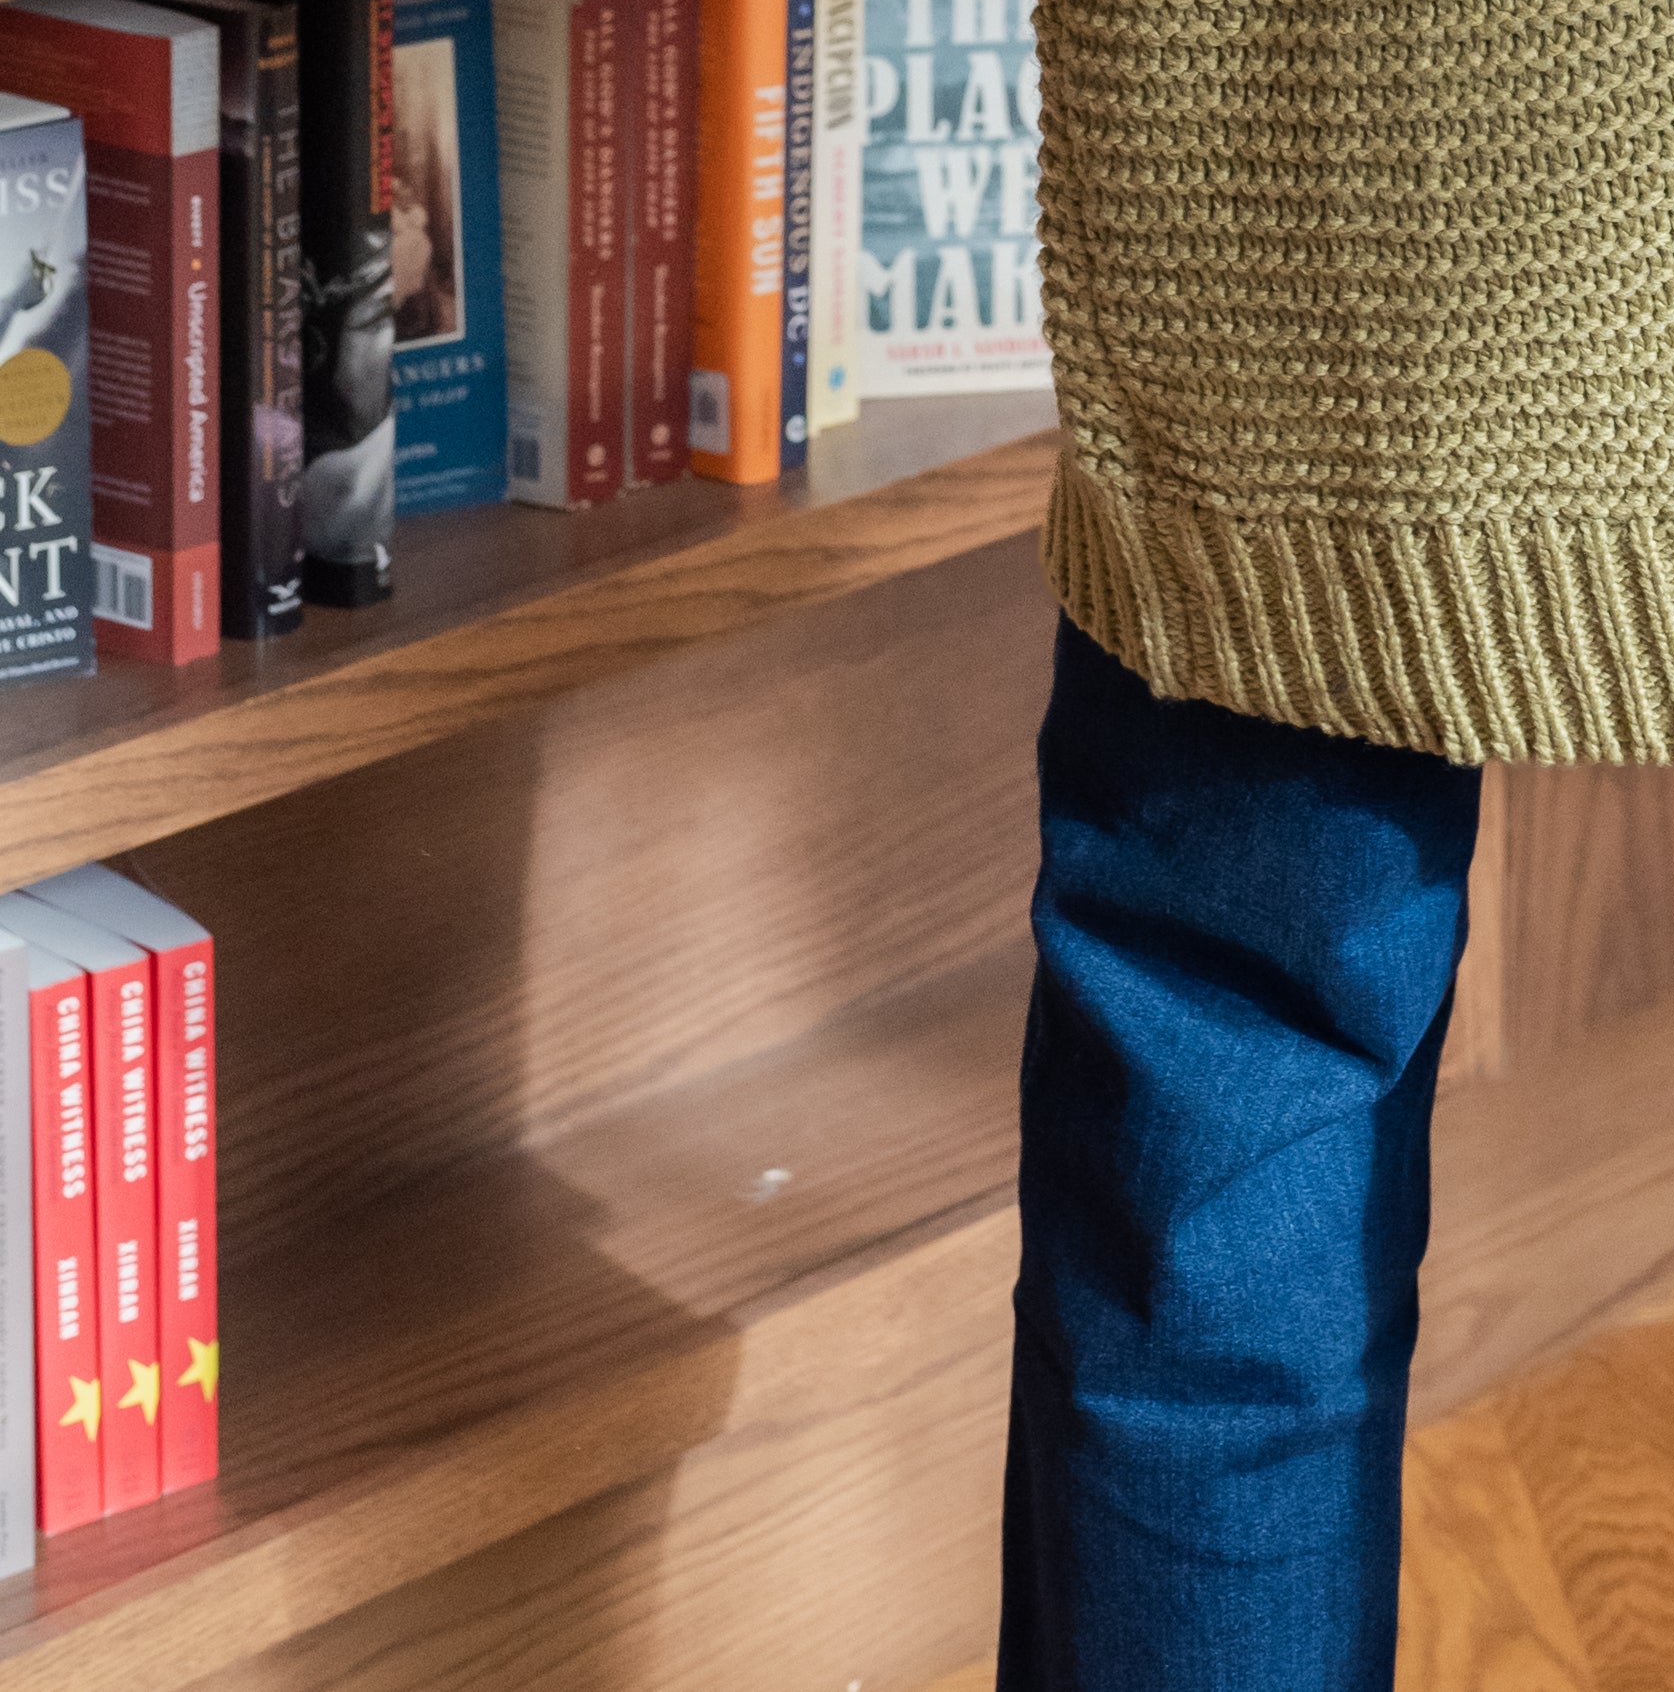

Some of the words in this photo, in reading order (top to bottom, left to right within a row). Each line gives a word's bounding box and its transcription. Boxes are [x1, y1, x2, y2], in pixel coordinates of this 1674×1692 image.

[860, 53, 1042, 142] PLA
[276, 103, 301, 195] THE
[752, 84, 786, 202] FIFTH
[788, 26, 815, 276] INDIGENOUS
[278, 213, 302, 369] BEARS
[751, 214, 784, 296] SUN
[860, 246, 1044, 334] MAK
[186, 280, 209, 406] Unscripted
[786, 284, 810, 344] DC
[188, 410, 209, 504] America
[57, 995, 82, 1080] CHINA
[121, 980, 145, 1063] CHINA
[183, 960, 207, 1042] CHINA
[60, 1081, 87, 1200] WITNESS
[122, 1065, 148, 1183] WITNESS
[184, 1045, 209, 1162] WITNESS
[57, 1256, 80, 1341] XINRAN
[117, 1238, 140, 1324] XINRAN
[178, 1217, 200, 1302] XINRAN
